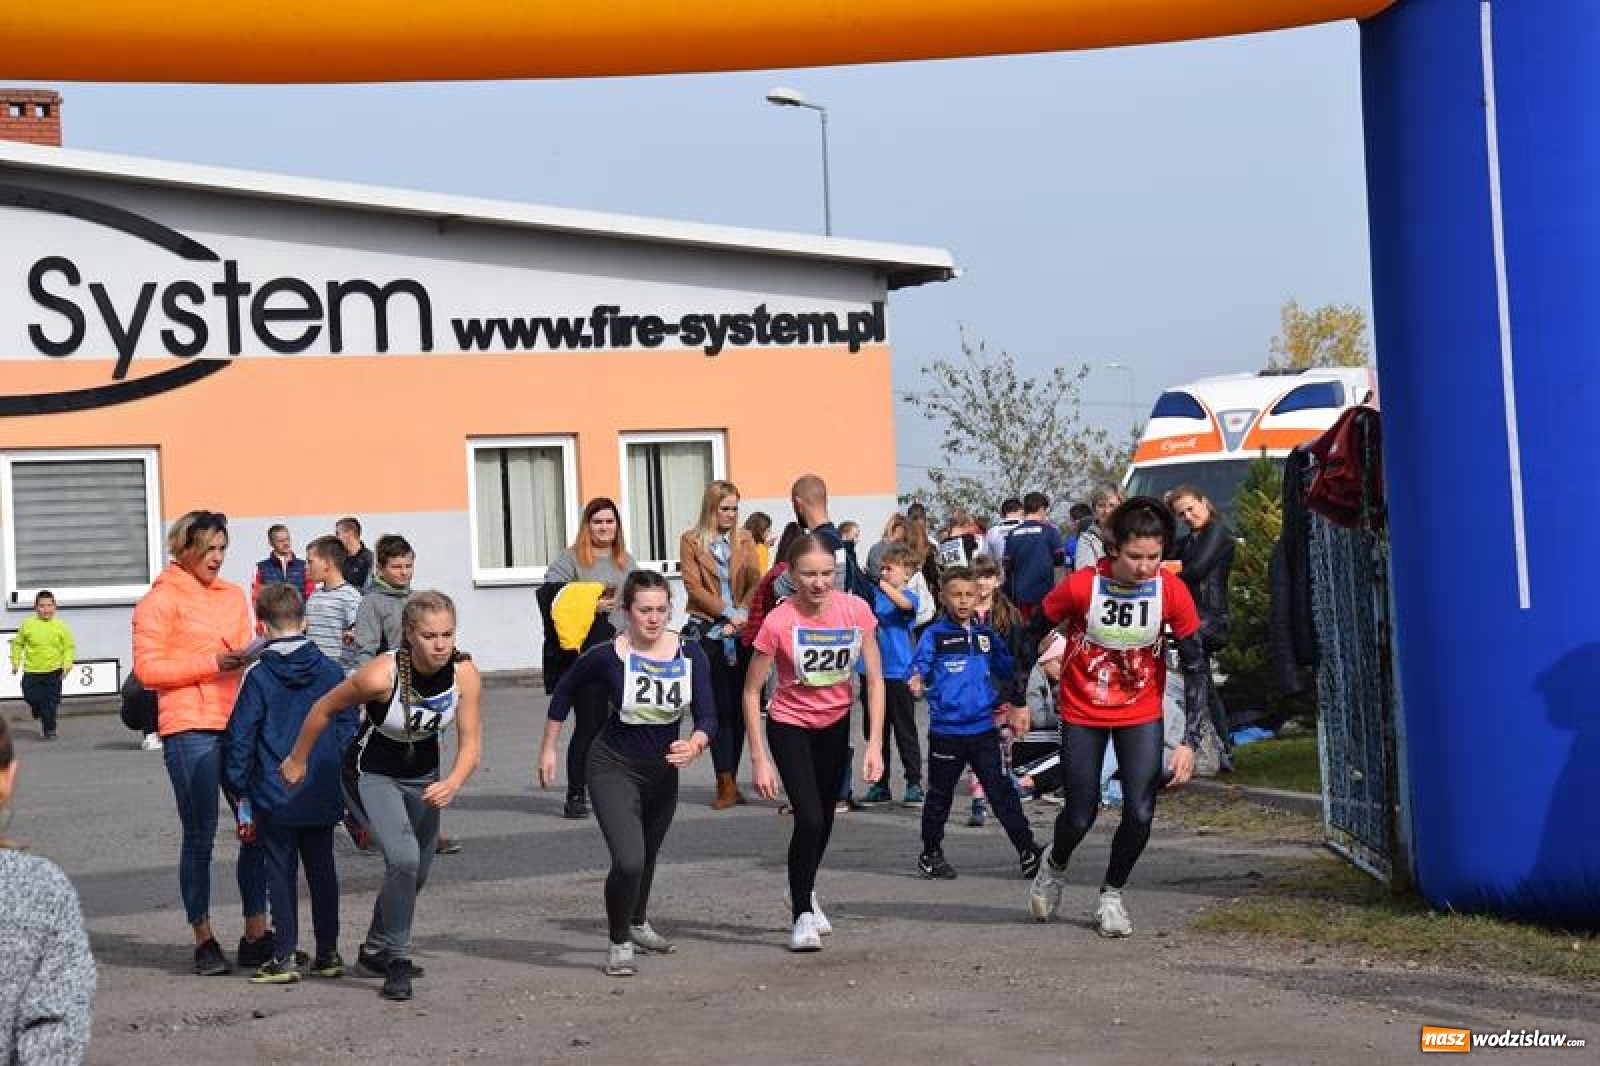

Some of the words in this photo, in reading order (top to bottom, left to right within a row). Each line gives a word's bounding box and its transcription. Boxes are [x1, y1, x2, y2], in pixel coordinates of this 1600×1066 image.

[27, 255, 434, 380] System
[451, 301, 885, 356] www.fire-system.pl
[1100, 599, 1149, 629] 361
[79, 665, 94, 687] 3
[803, 648, 851, 672] 220
[635, 675, 683, 709] 214
